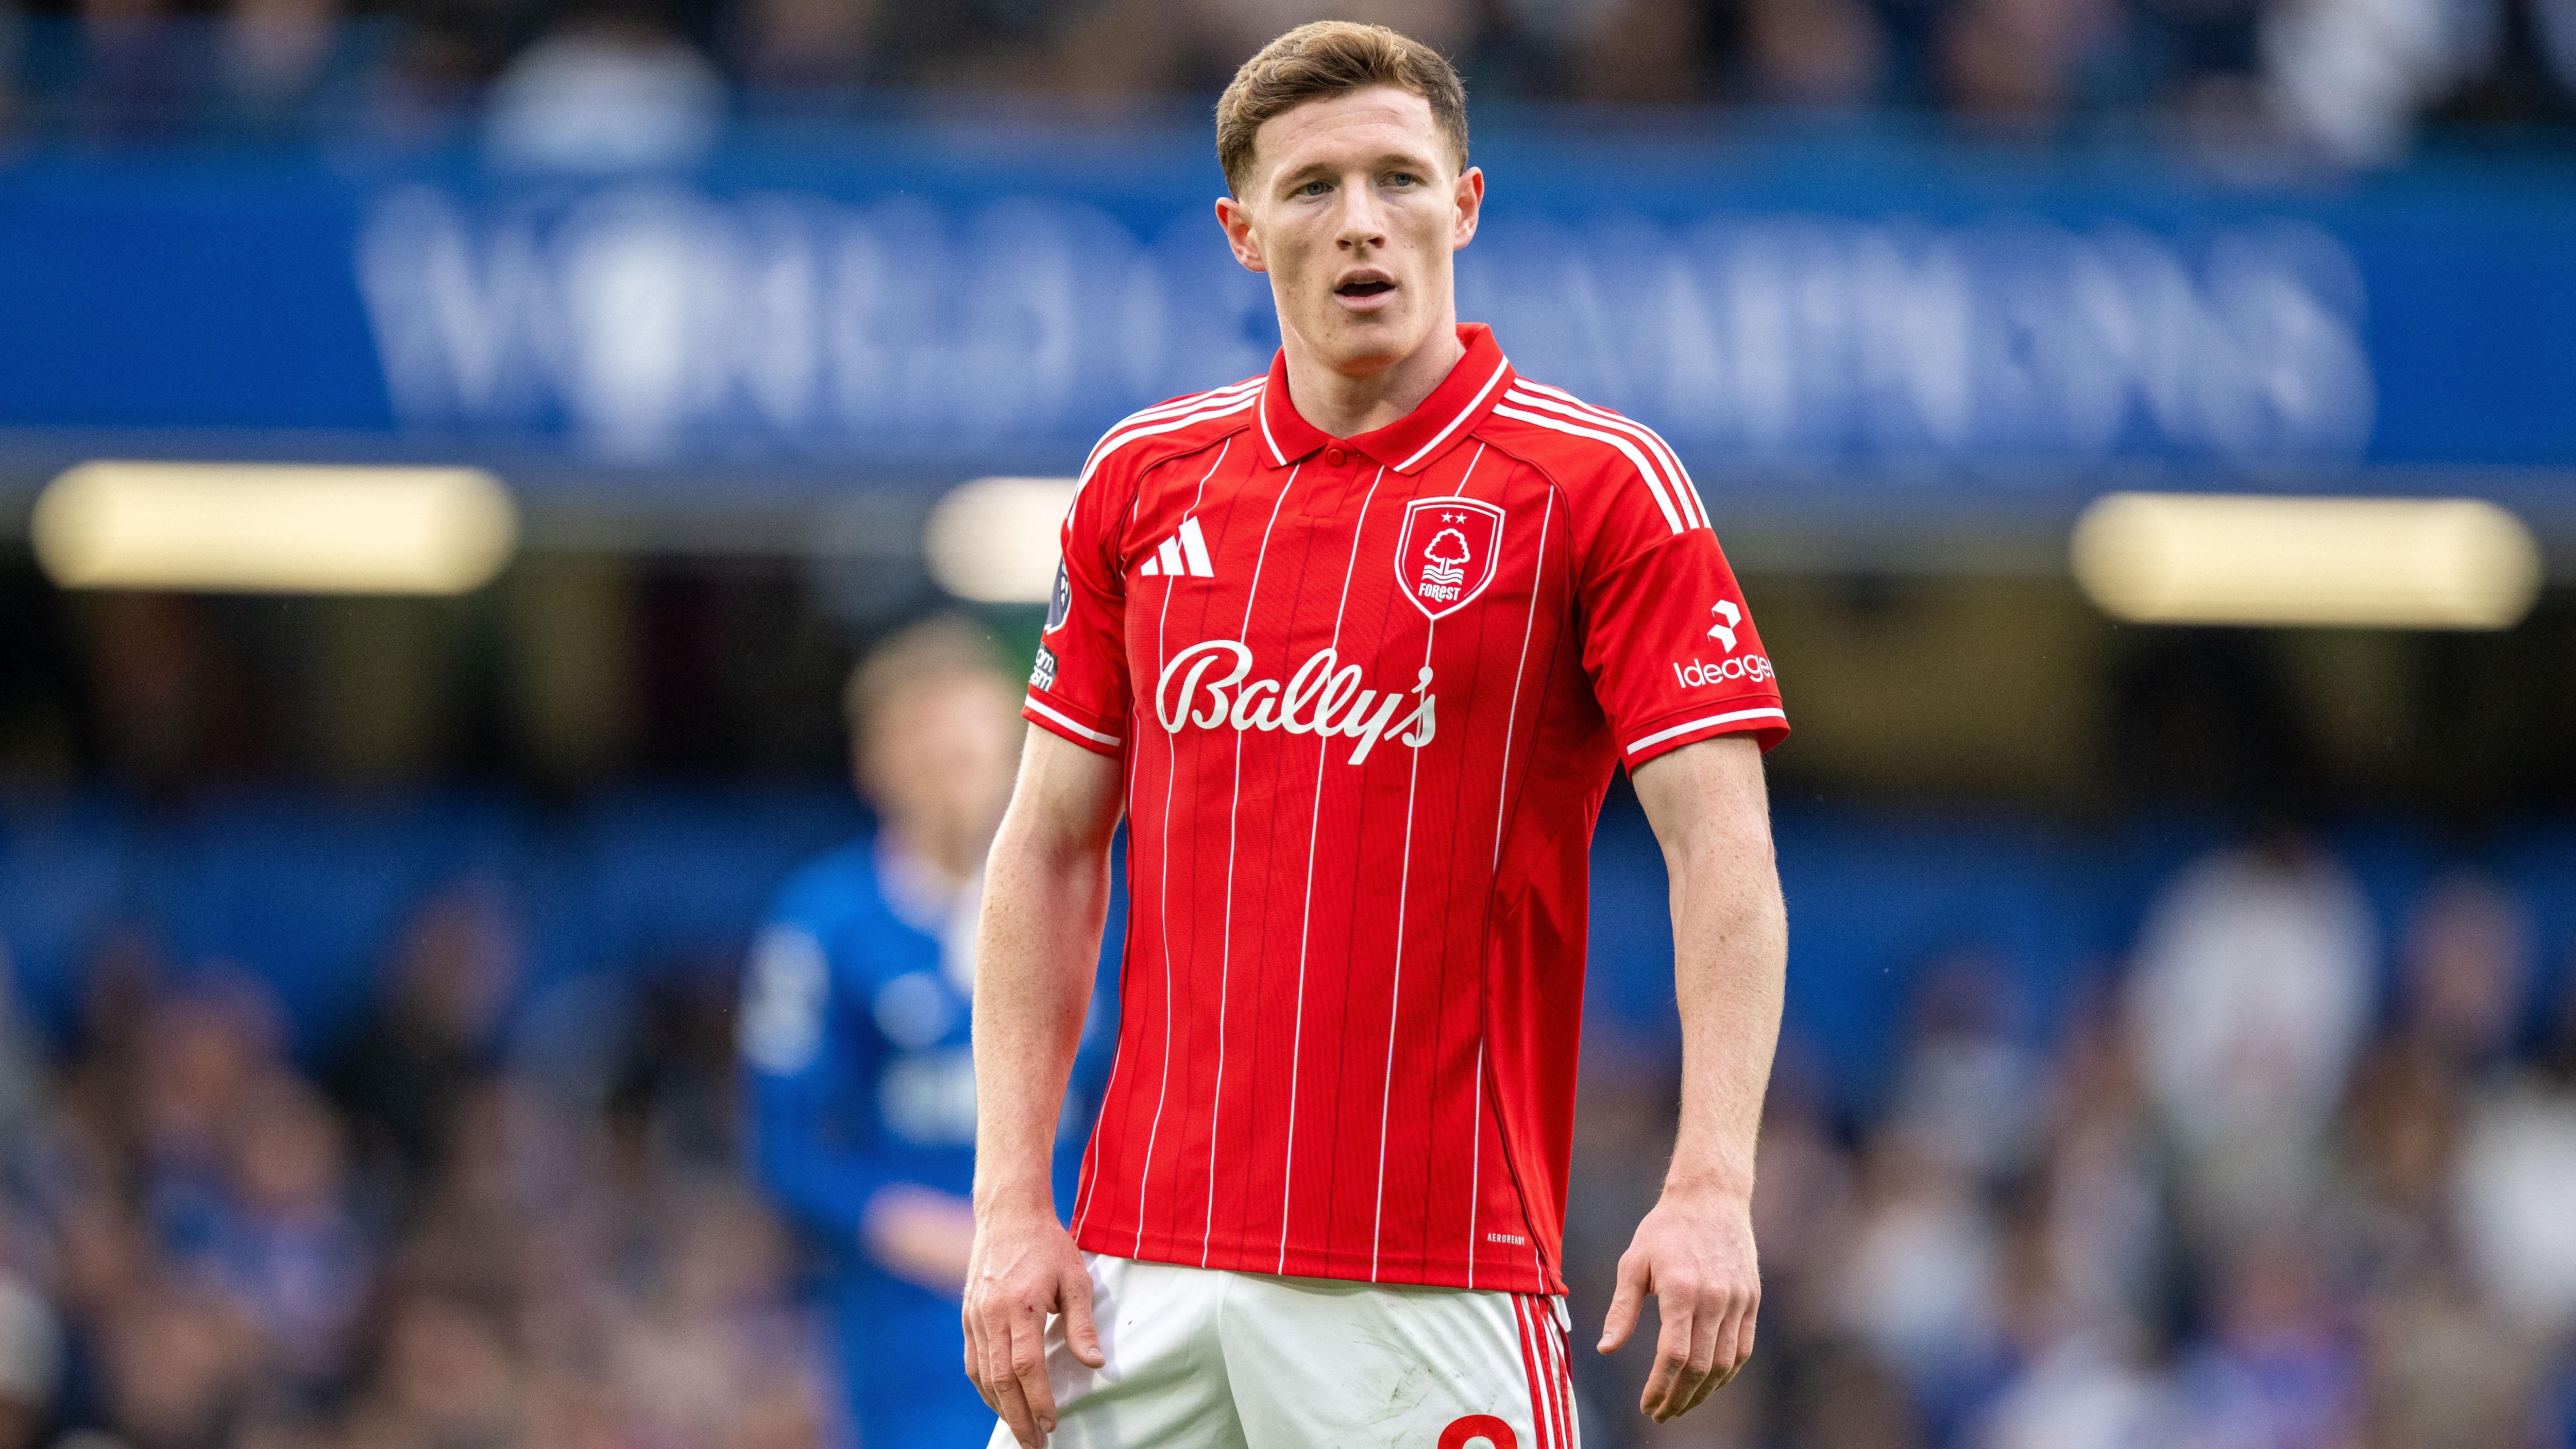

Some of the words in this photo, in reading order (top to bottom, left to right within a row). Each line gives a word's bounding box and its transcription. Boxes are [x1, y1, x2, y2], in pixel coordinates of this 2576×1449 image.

[1113, 201, 2370, 458] CAMPIONS
[1156, 639, 1436, 765] Bally's
[1487, 1233, 1524, 1246] AEROREADY
